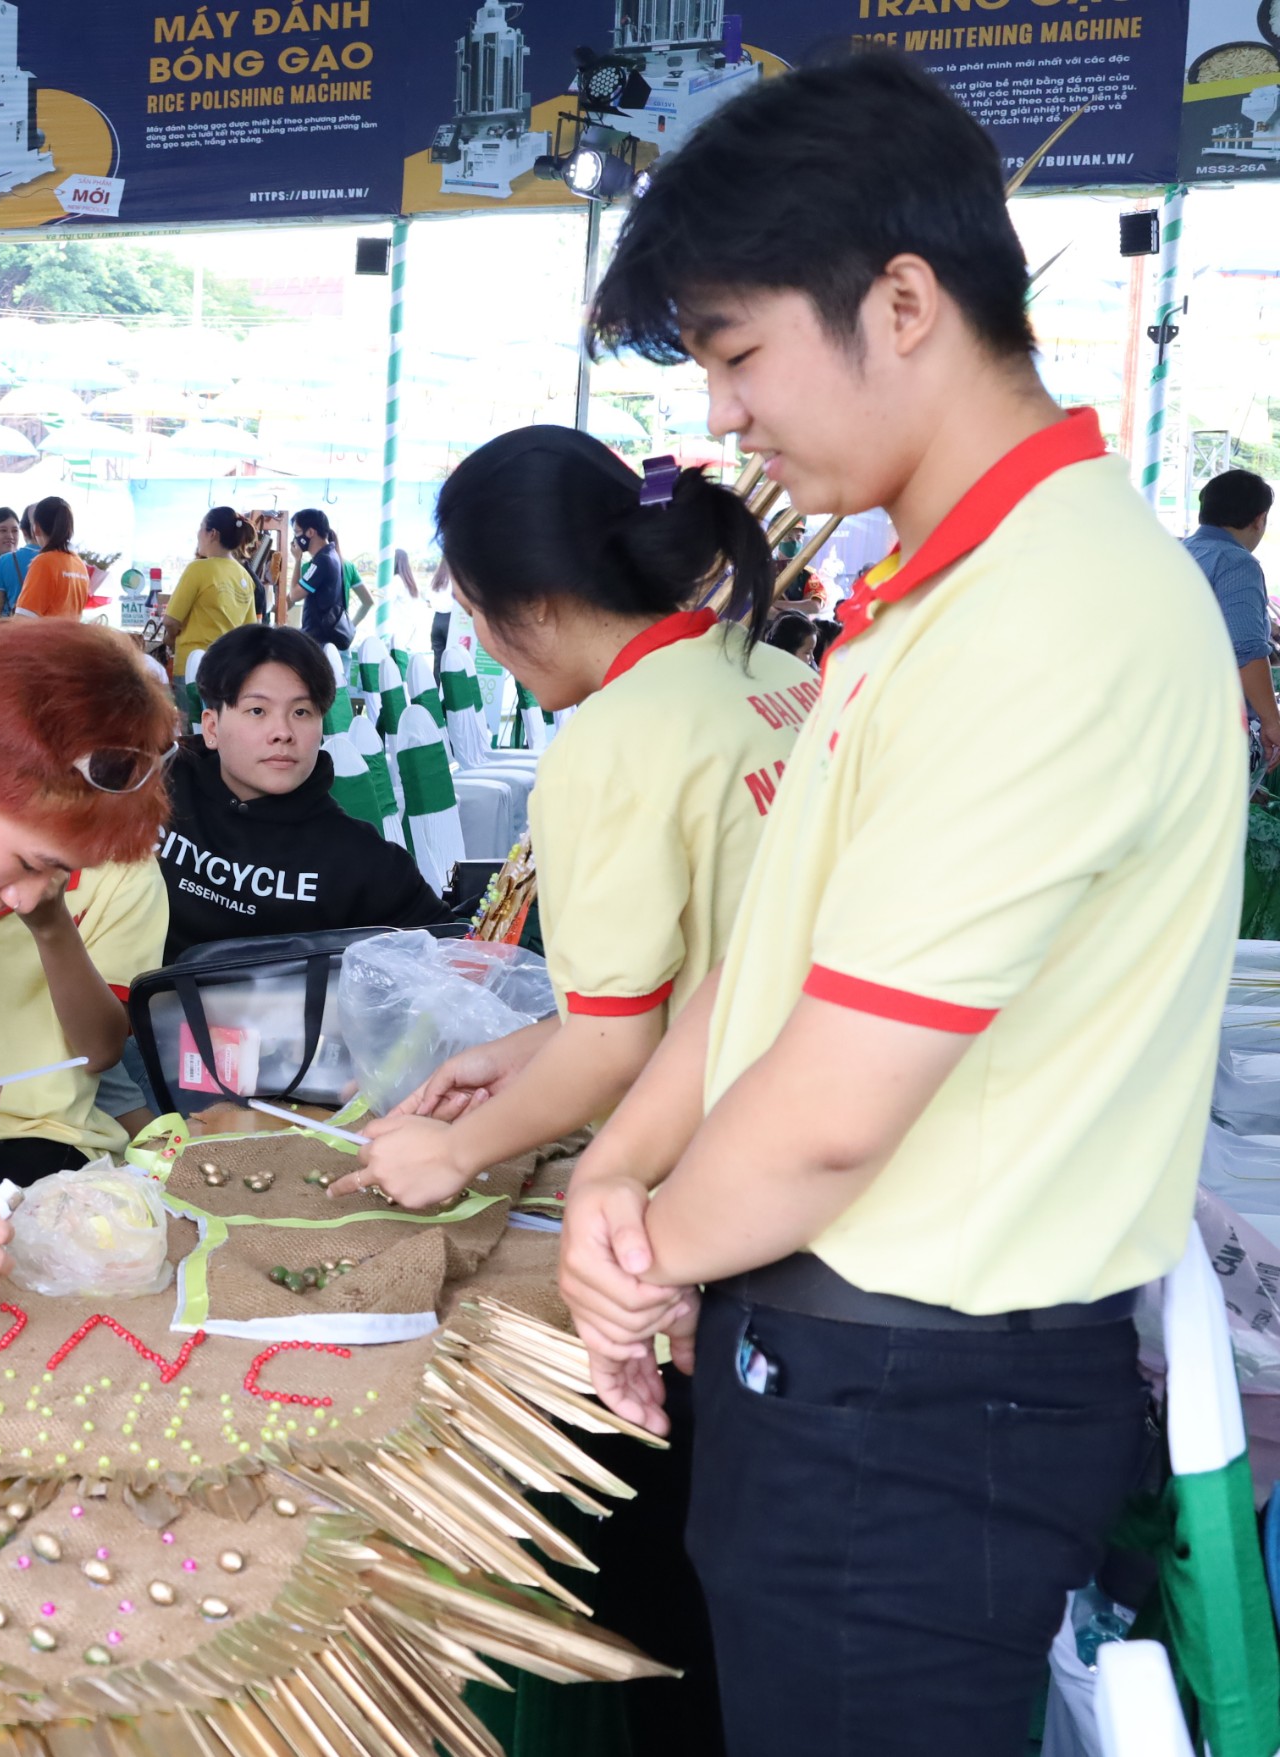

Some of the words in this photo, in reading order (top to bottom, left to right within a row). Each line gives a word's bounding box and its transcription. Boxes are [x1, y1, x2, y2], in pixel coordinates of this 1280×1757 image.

[154, 5, 241, 44] MÁY
[252, 0, 369, 36] ĐÁNH
[904, 23, 1032, 52] WHITENING
[1040, 16, 1143, 43] MACHINE
[149, 46, 265, 84] BÓNG
[278, 41, 374, 80] GẠO
[147, 92, 184, 114] RICE
[190, 85, 284, 111] POLISHING
[290, 80, 372, 104] MACHINE
[1196, 163, 1267, 174] MSS2-26A
[72, 187, 110, 205] MỚI
[249, 188, 369, 202] HTTPS://BUIVAN.VN/
[178, 877, 257, 916] ESSENTIALS
